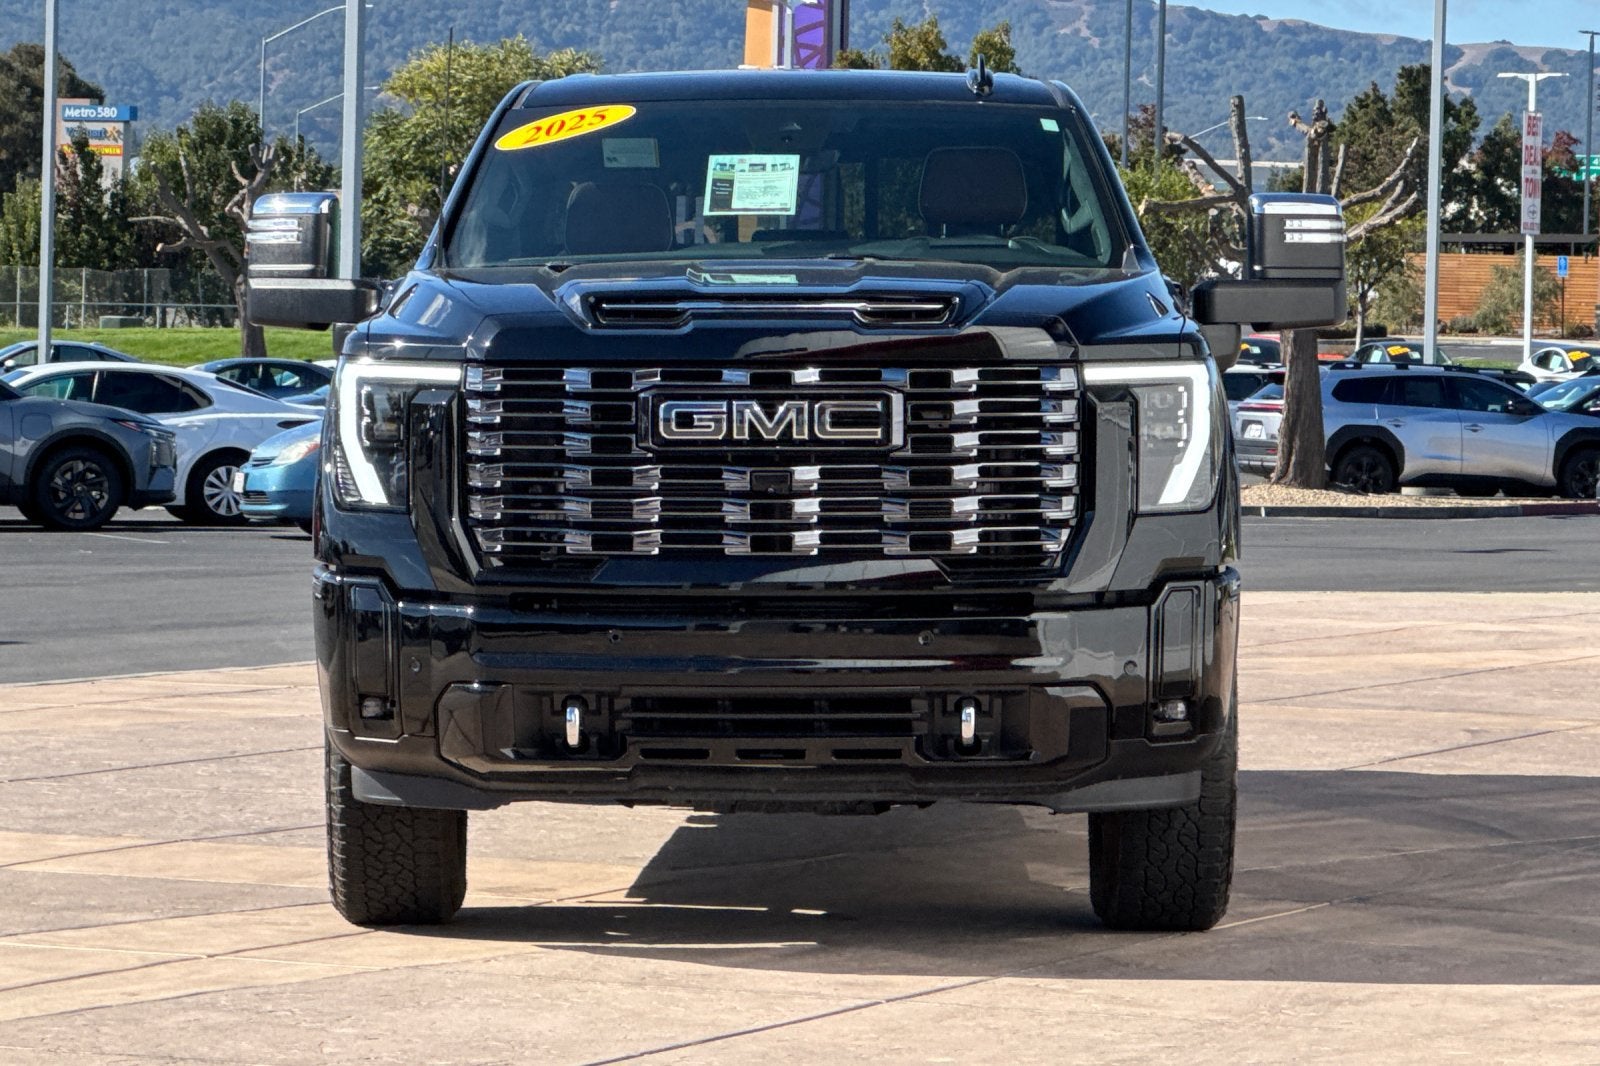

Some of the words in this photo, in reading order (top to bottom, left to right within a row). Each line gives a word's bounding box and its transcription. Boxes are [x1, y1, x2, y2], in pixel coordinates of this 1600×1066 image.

[64, 106, 97, 118] Metro
[97, 106, 118, 118] 580
[521, 108, 610, 145] 2025
[658, 400, 882, 440] GMC
